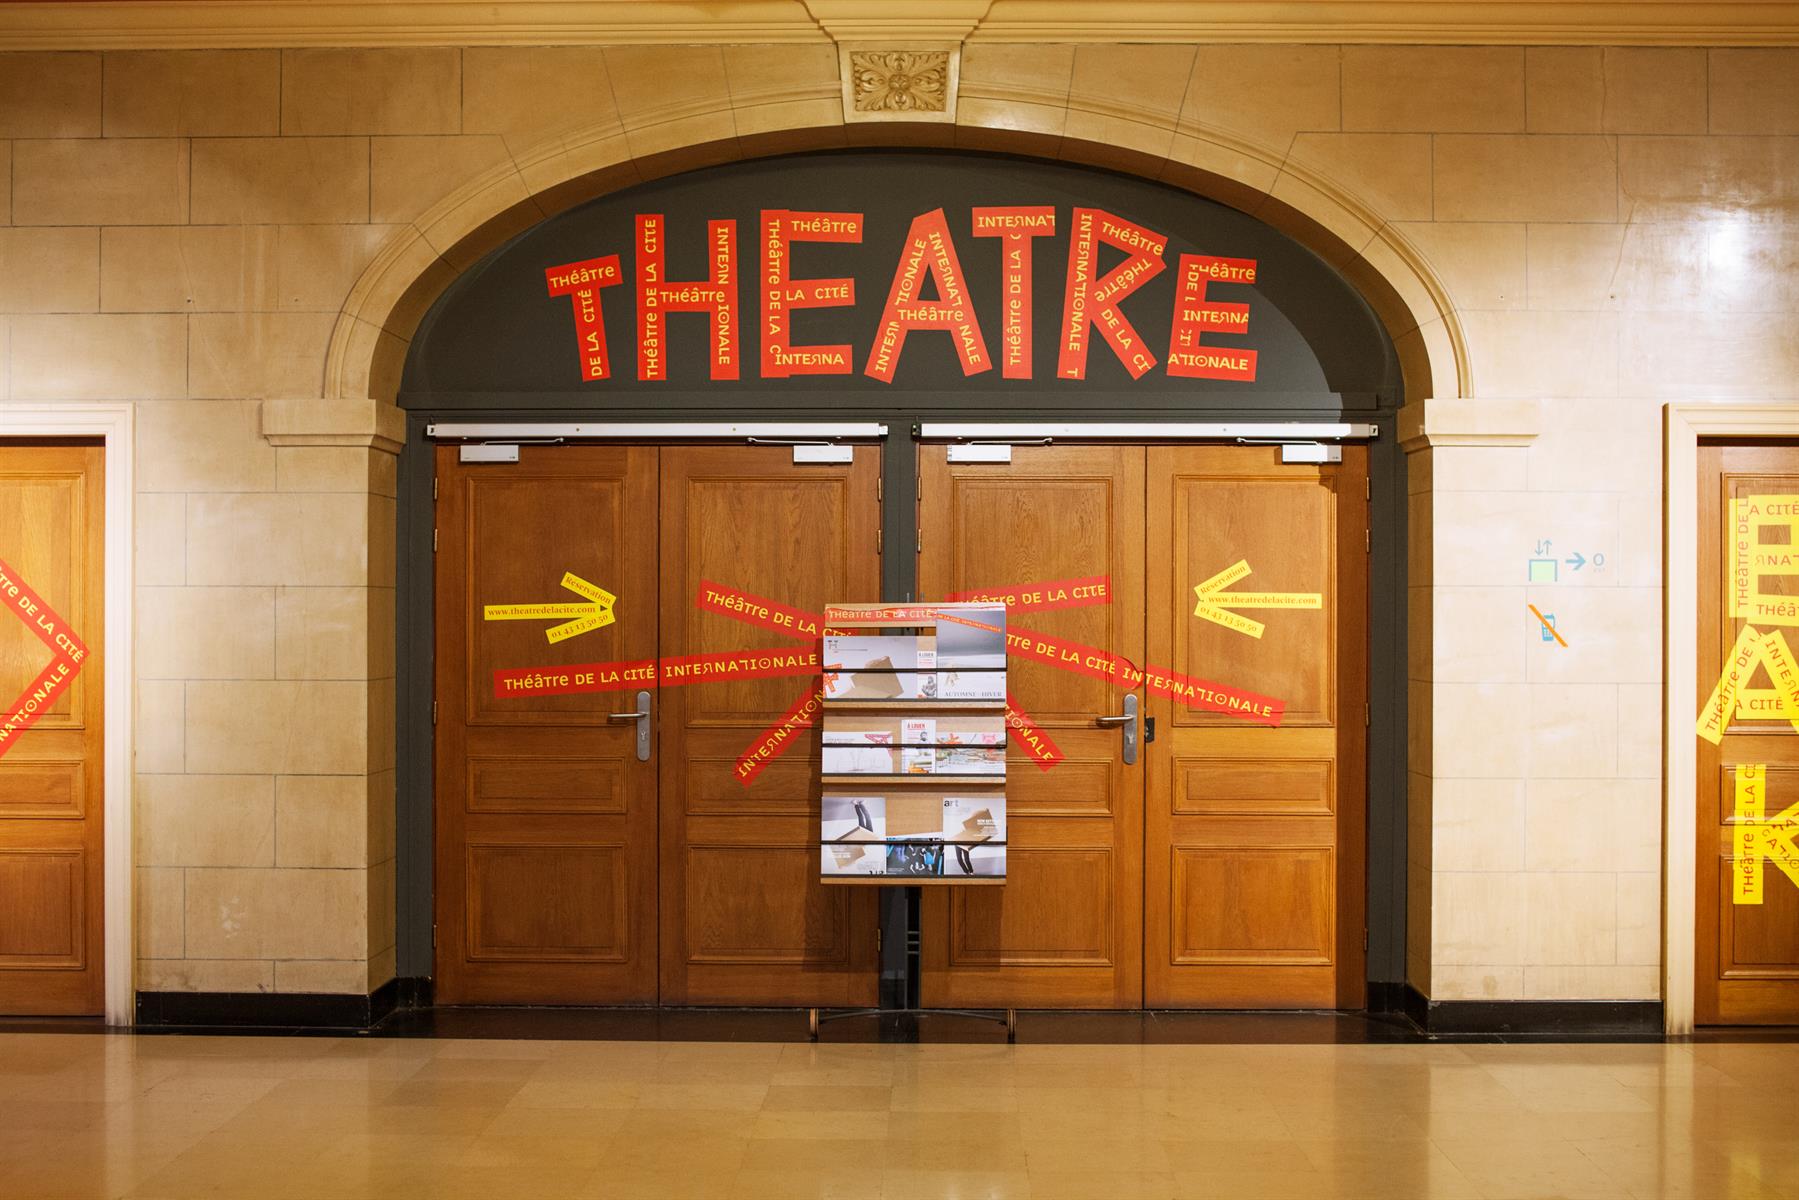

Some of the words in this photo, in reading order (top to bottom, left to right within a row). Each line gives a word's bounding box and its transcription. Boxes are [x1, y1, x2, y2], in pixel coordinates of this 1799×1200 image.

[1010, 250, 1021, 269] LA
[645, 263, 657, 282] LA
[1186, 271, 1200, 291] DE
[1010, 274, 1021, 293] DE
[646, 287, 657, 307] DE
[769, 291, 781, 310] DE
[785, 290, 805, 301] LA
[769, 315, 781, 335] LA
[1101, 308, 1120, 329] DE
[1116, 329, 1133, 350] LA
[586, 331, 600, 352] LA
[589, 356, 603, 377] DE
[1738, 514, 1749, 534] DE
[1022, 592, 1042, 604] DE
[1048, 589, 1067, 601] LA
[18, 595, 39, 616] DE
[37, 614, 55, 635] LA
[773, 611, 794, 627] DE
[797, 619, 817, 635] LA
[1035, 642, 1056, 657] DE
[1061, 649, 1080, 664] LA
[1736, 647, 1754, 668] DE
[575, 672, 594, 686] DE
[600, 670, 620, 683] LA
[1744, 785, 1755, 804] LA
[1744, 809, 1755, 826] DE
